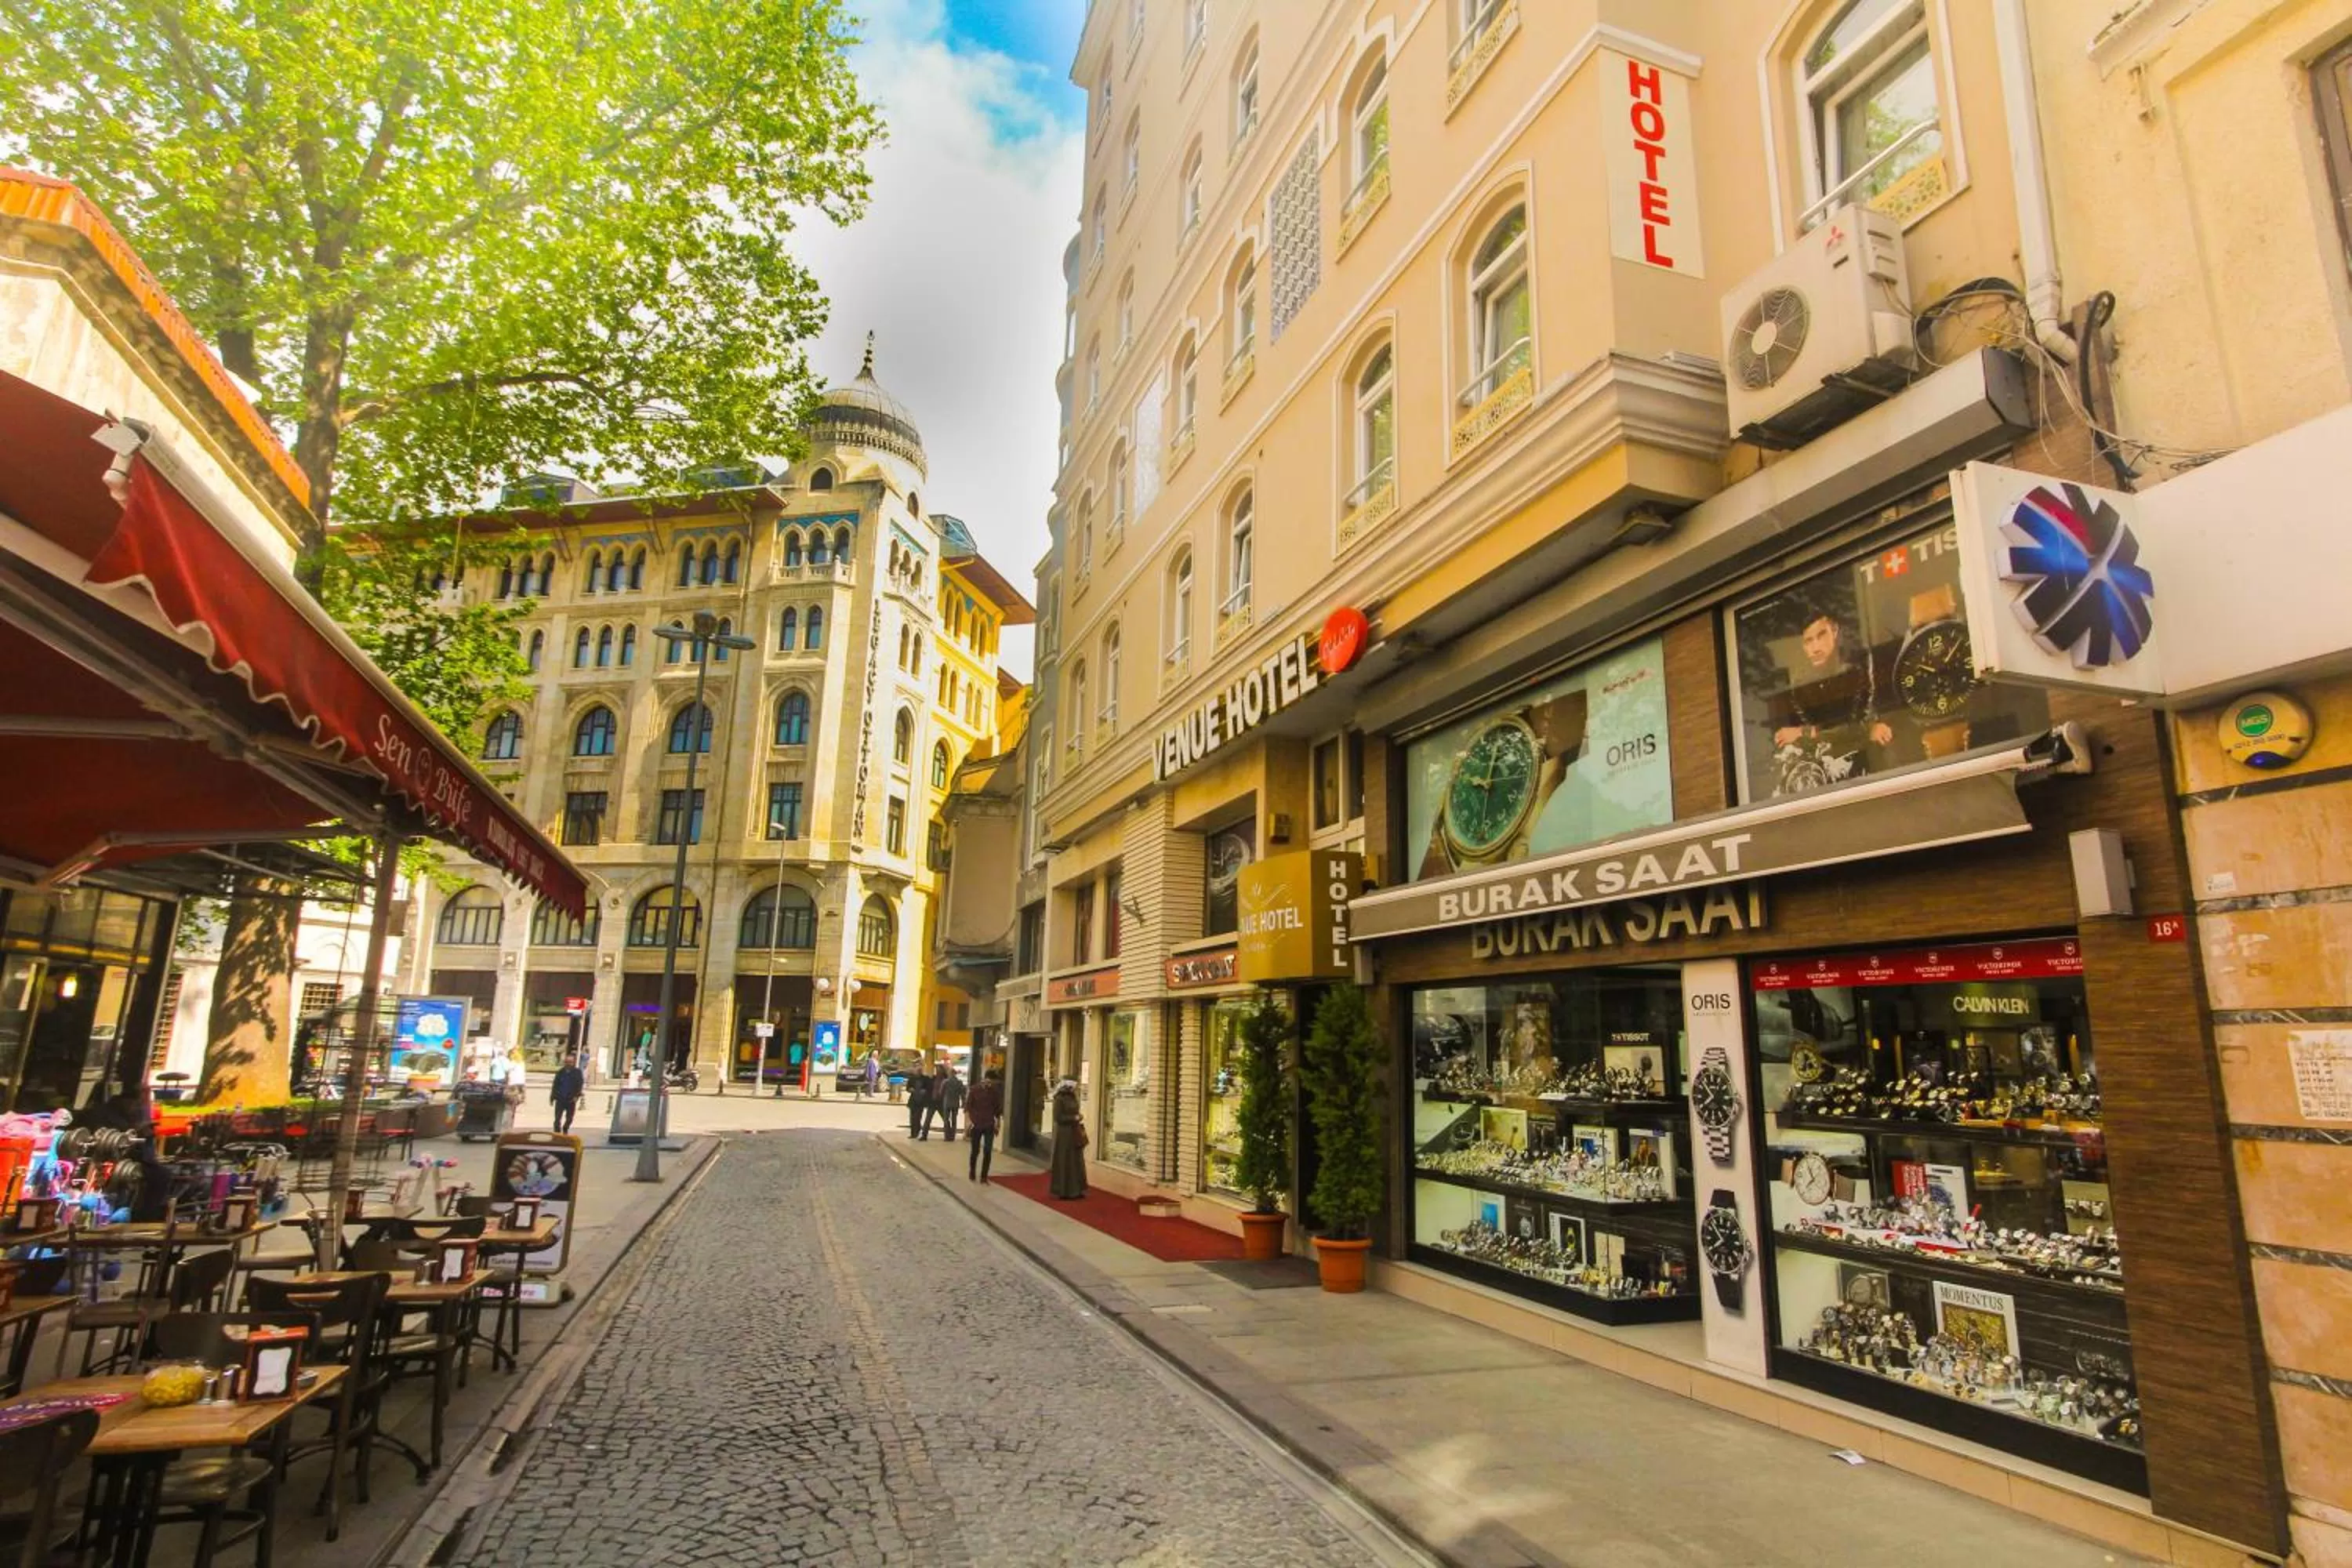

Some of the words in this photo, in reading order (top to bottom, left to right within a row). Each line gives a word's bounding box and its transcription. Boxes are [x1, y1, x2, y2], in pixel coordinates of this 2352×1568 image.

[1627, 60, 1674, 268] HOTEL
[1911, 528, 1958, 562] TIS
[1152, 699, 1221, 782] VENUE
[1225, 635, 1319, 740] HOTEL
[1607, 734, 1656, 766] ORIS
[1439, 869, 1584, 921] BURAK
[1595, 833, 1751, 893] SAAT
[1260, 906, 1304, 934] HOTEL
[1329, 860, 1348, 967] HOTEL
[1691, 993, 1730, 1011] ORIS
[1953, 996, 1997, 1013] CALVIN
[1940, 1286, 2004, 1312] MOMENTUS
